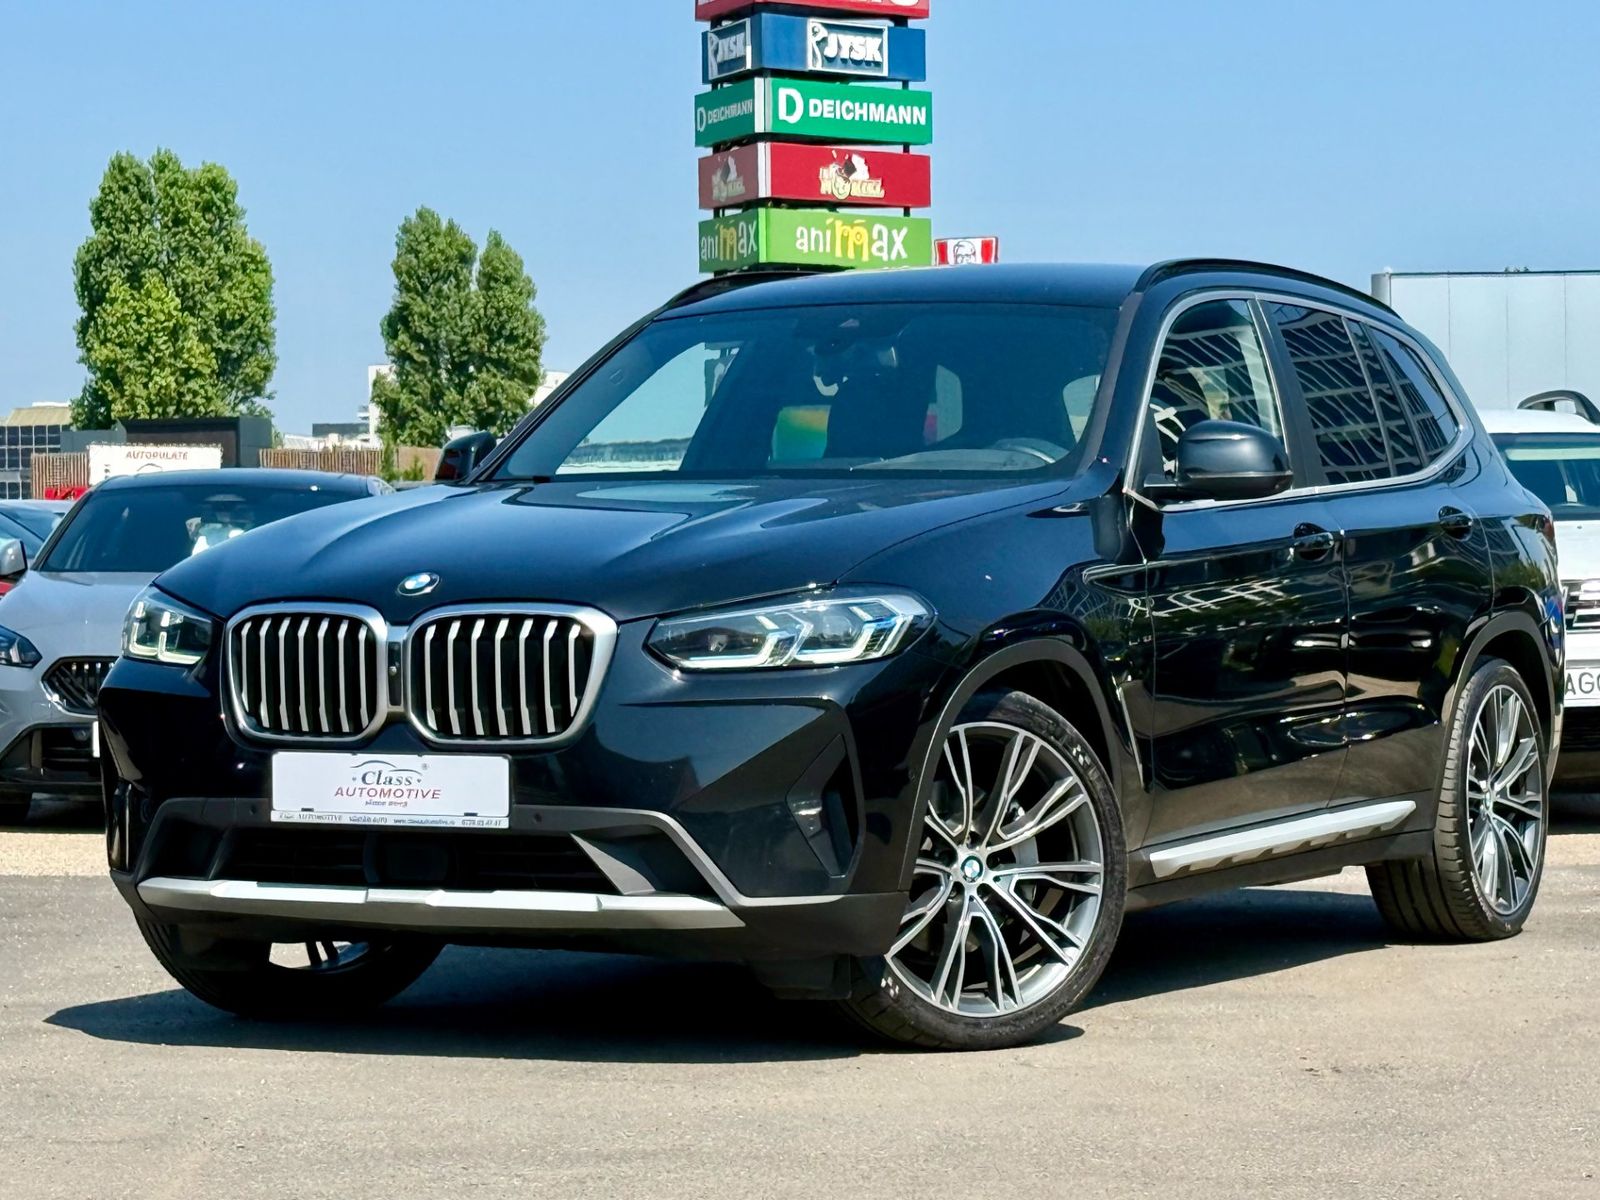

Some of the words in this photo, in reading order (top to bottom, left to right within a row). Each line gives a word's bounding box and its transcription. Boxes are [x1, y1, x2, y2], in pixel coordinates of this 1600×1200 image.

[823, 32, 883, 63] JYSK
[697, 106, 707, 132] D
[707, 99, 753, 124] DEICHMANN
[778, 87, 804, 124] D
[808, 98, 927, 125] DEICHMANN
[795, 217, 909, 262] animax
[1564, 672, 1600, 695] AG
[334, 786, 442, 800] AUTOMOTIVE
[361, 769, 413, 786] Class
